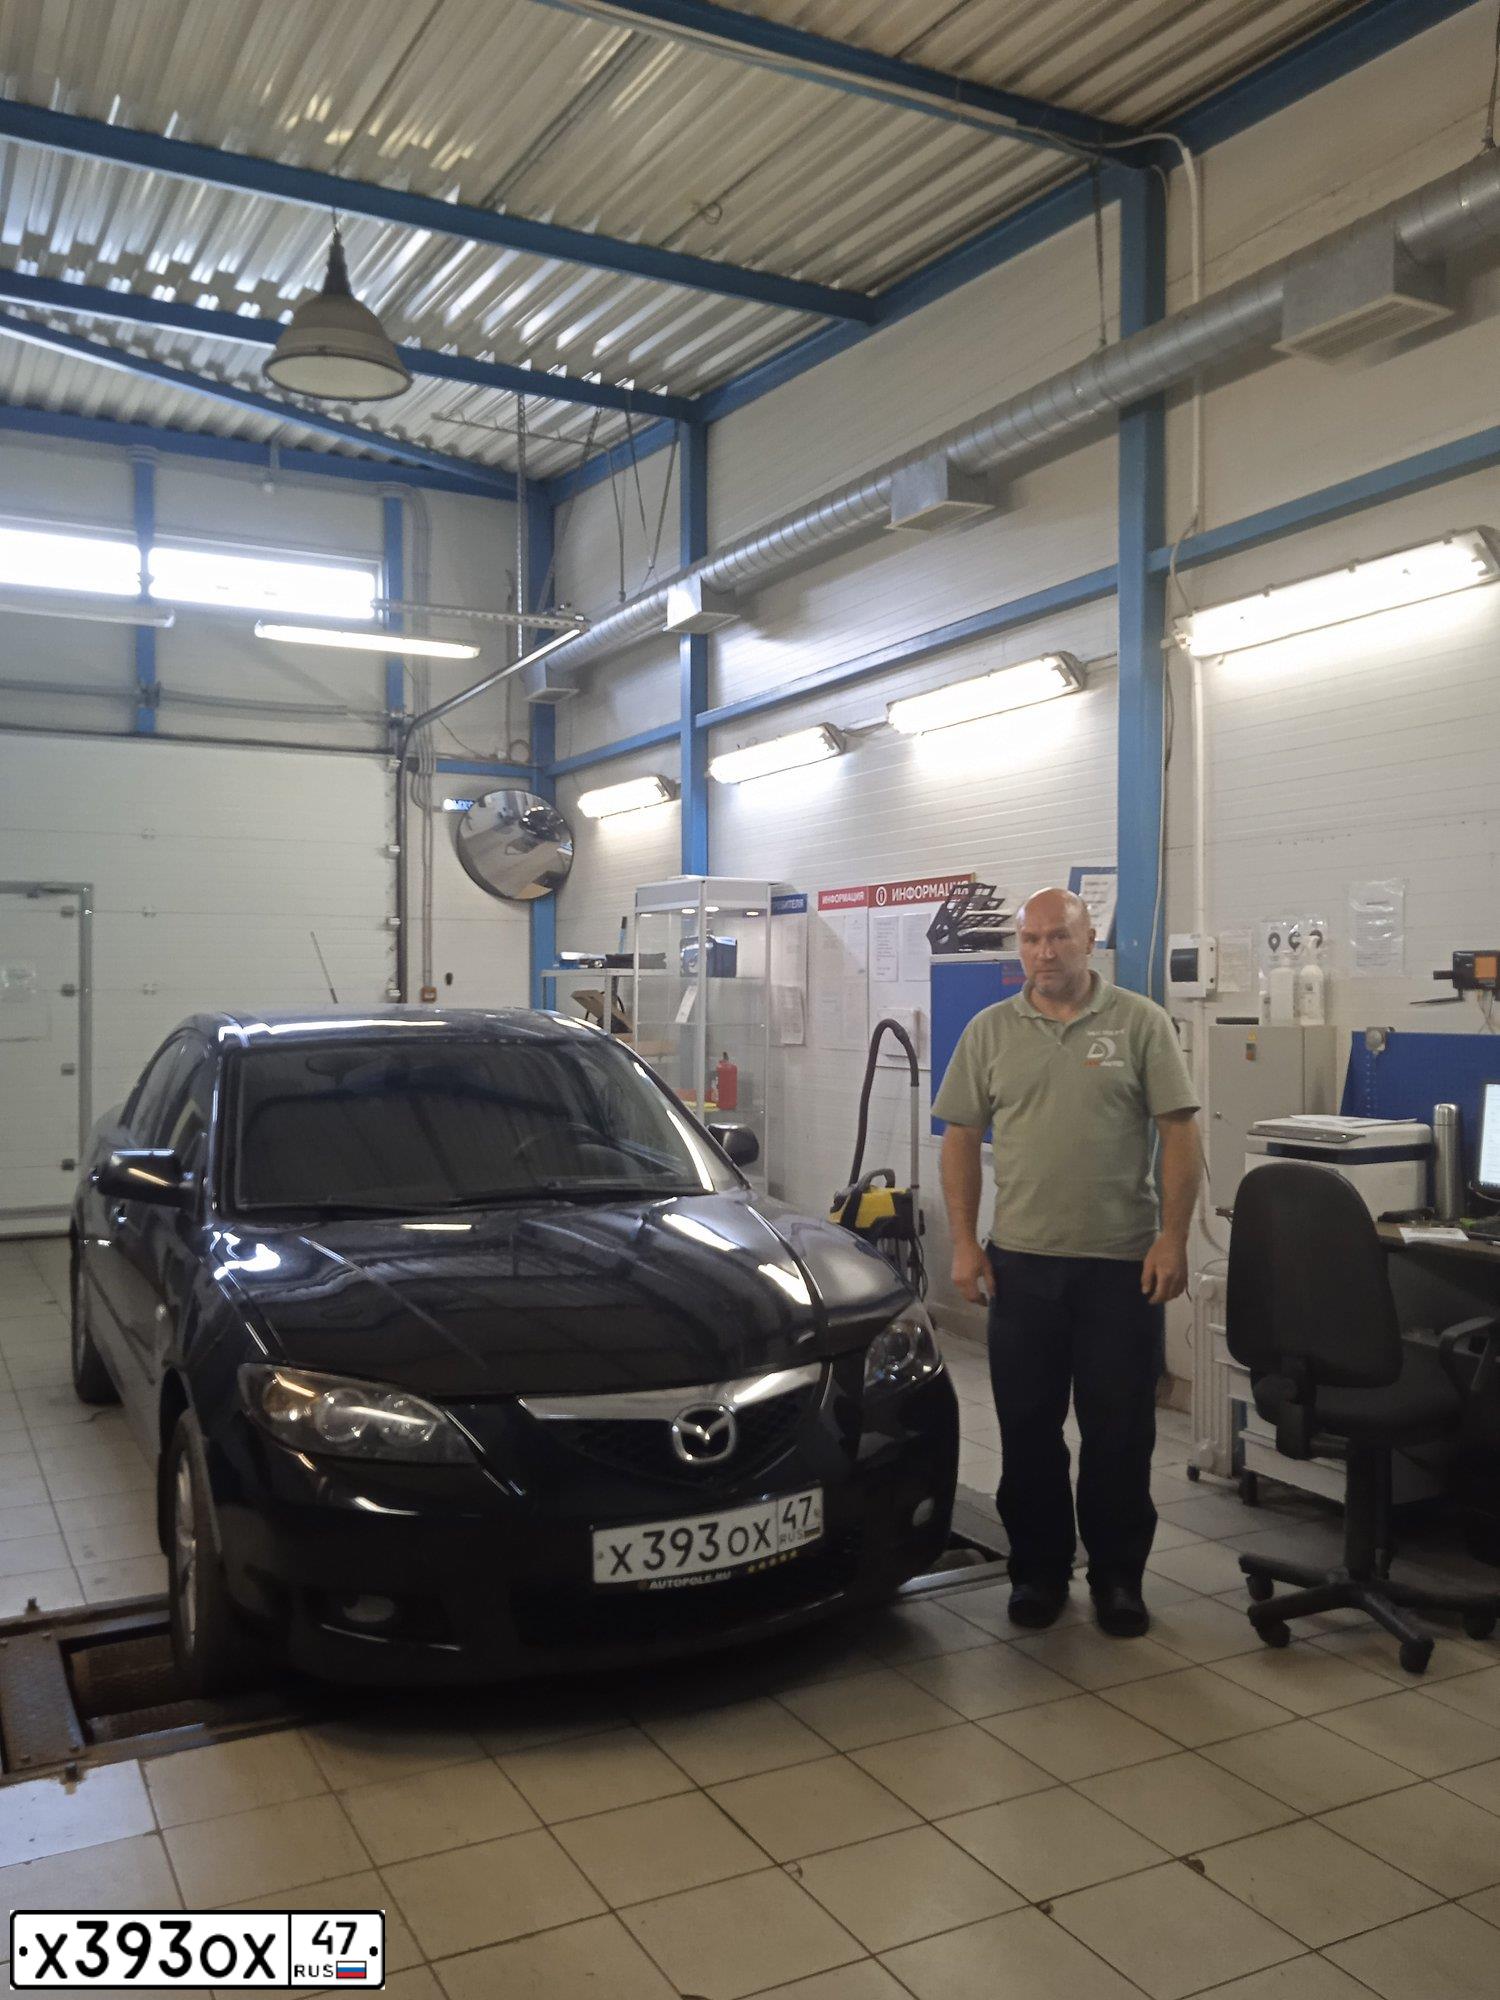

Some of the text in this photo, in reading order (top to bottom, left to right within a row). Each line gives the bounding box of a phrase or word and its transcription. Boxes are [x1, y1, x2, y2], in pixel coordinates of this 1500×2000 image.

[821, 890, 865, 904] ИНФОРМАЦИЯ
[610, 1495, 813, 1576] Х393ОХ 47
[779, 1529, 804, 1545] RUS
